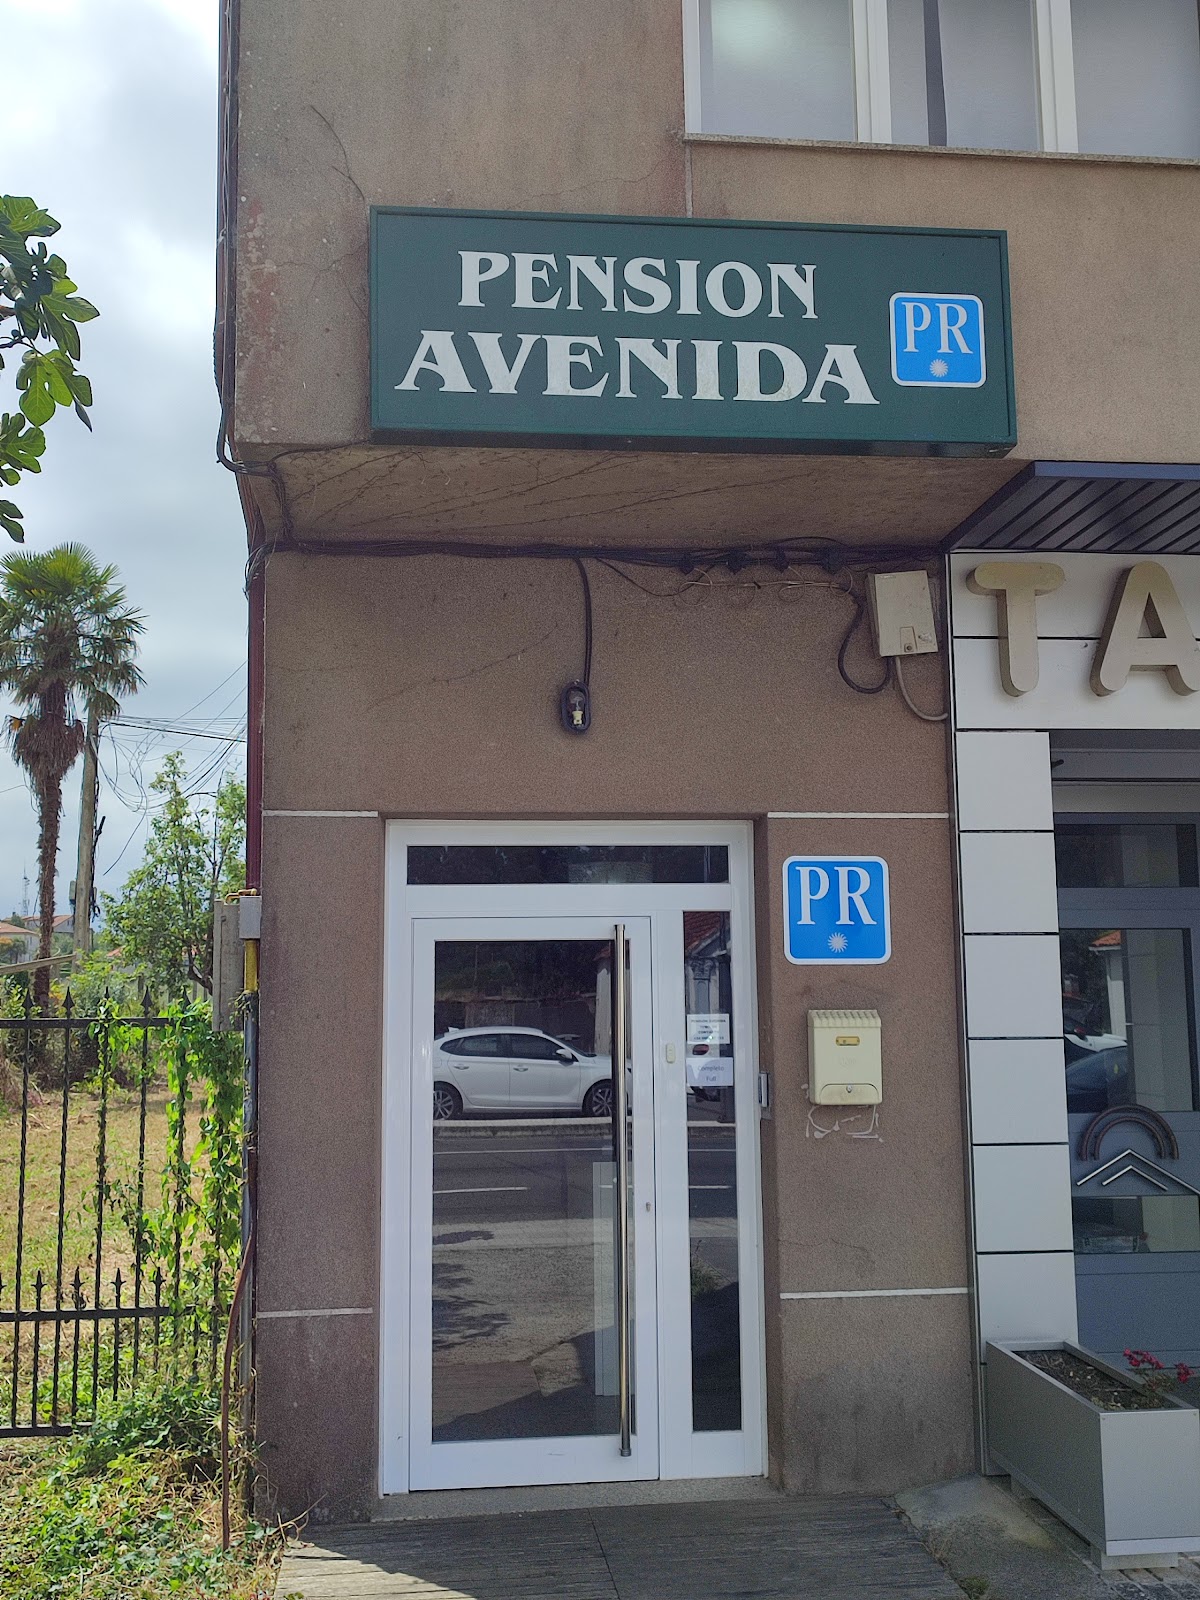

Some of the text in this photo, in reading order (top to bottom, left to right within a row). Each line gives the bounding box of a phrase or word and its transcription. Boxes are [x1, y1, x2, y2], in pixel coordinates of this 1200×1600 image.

[458, 250, 819, 320] PENSION
[904, 301, 973, 355] PR
[393, 329, 881, 405] AVENIDA
[966, 560, 1200, 697] TA
[796, 867, 877, 925] PR
